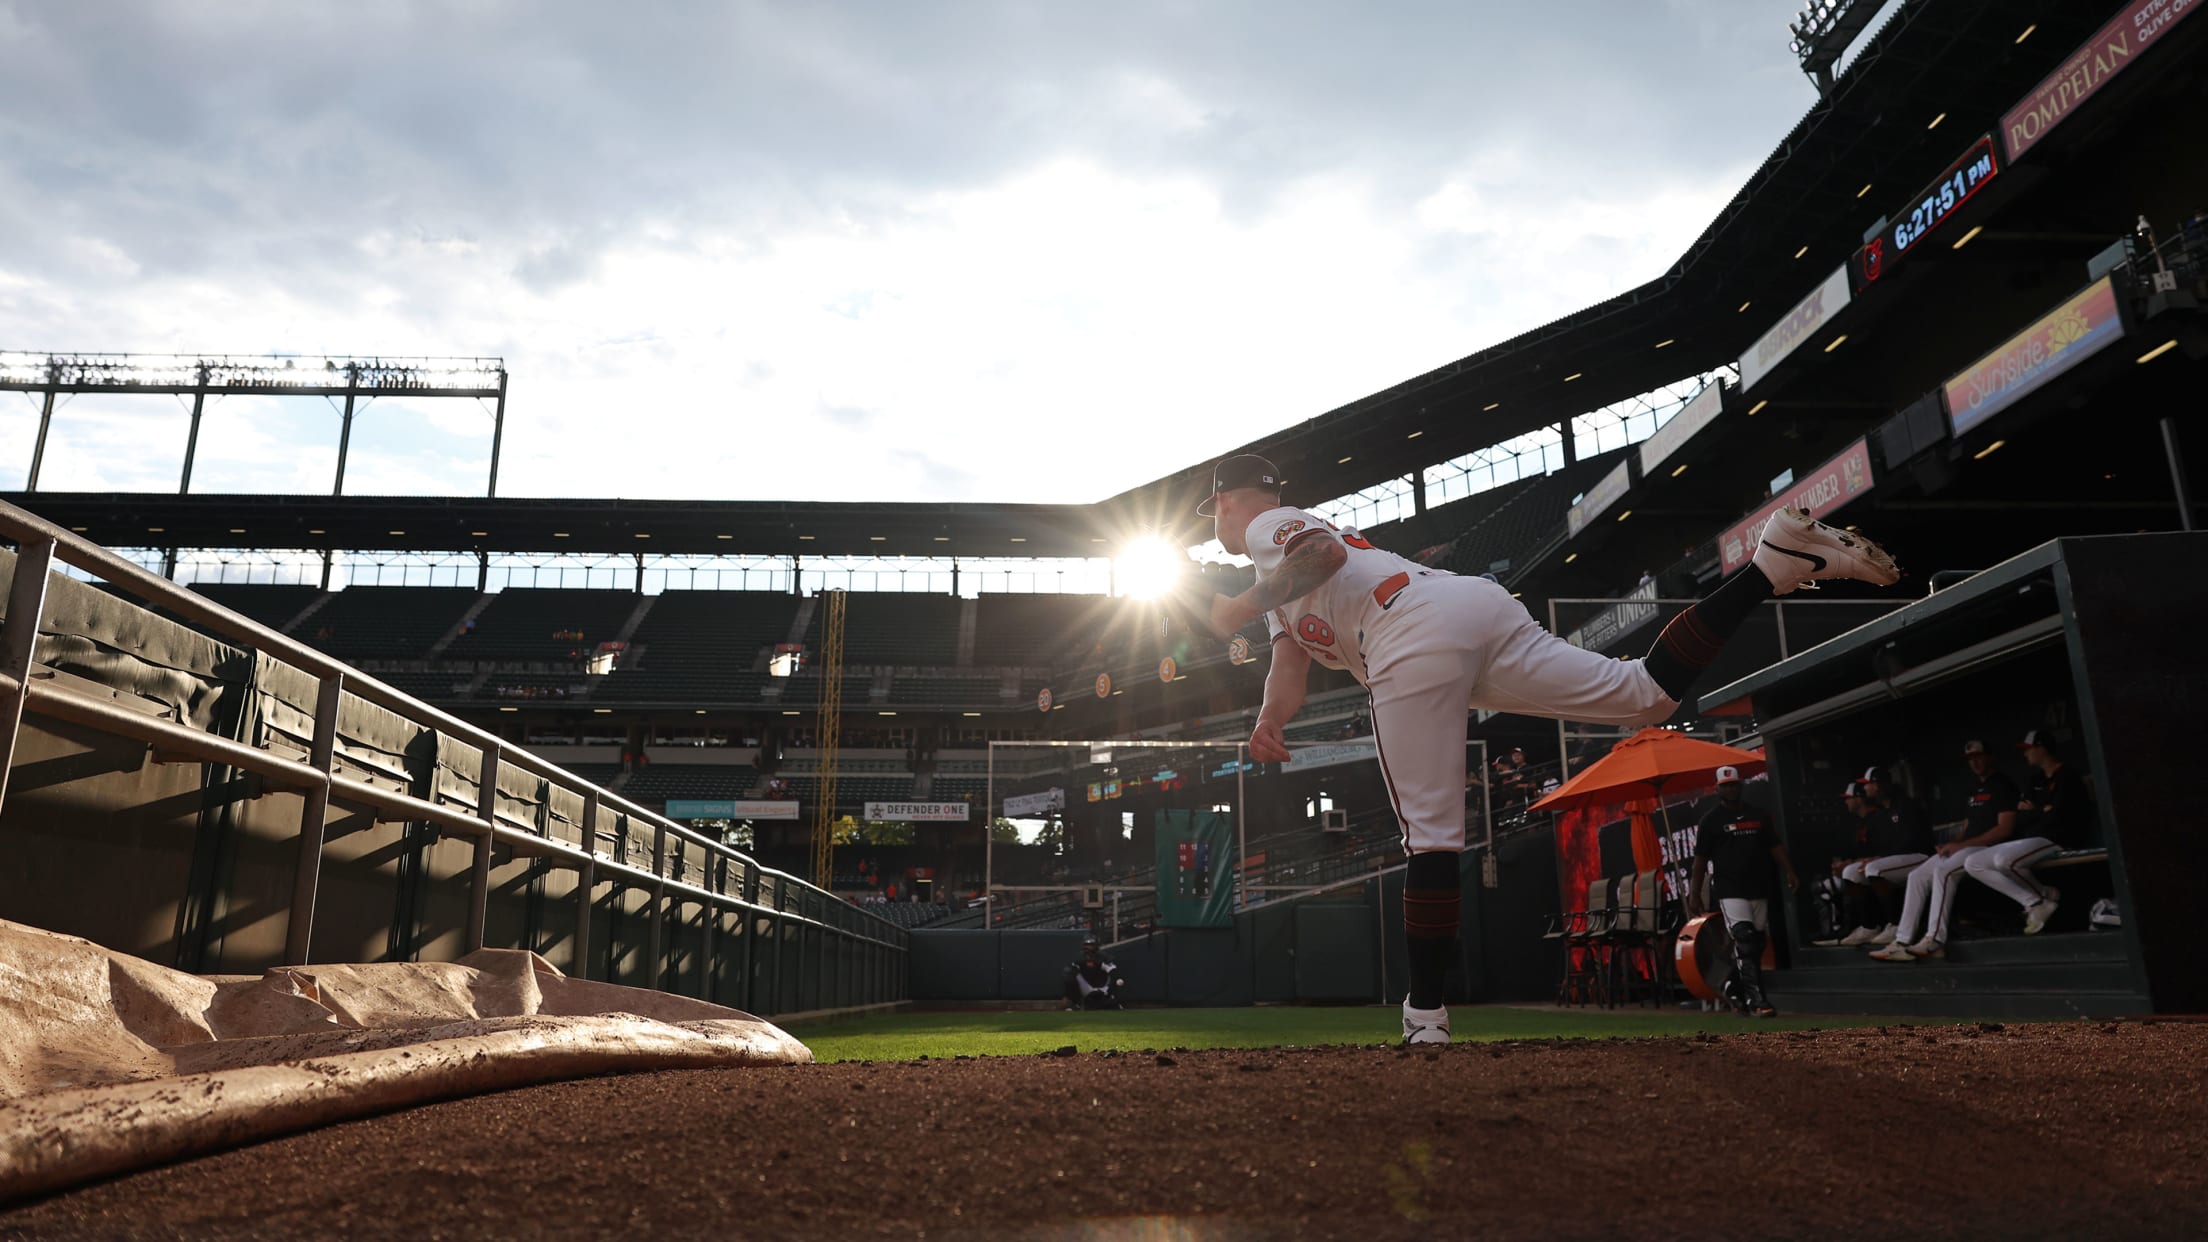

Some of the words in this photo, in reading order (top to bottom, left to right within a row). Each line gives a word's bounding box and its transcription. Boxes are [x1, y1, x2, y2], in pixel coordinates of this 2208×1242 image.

[2137, 6, 2173, 43] OLIVE
[2010, 31, 2130, 151] POMPEIAN
[1894, 170, 1967, 250] 6:27:51
[1967, 154, 1992, 187] PM
[1968, 335, 2045, 409] Surfside
[1793, 473, 1840, 515] LUMBER
[1617, 580, 1657, 629] UNION
[1038, 694, 1051, 707] 20
[887, 804, 941, 814] DEFENDER
[943, 804, 965, 814] ONE
